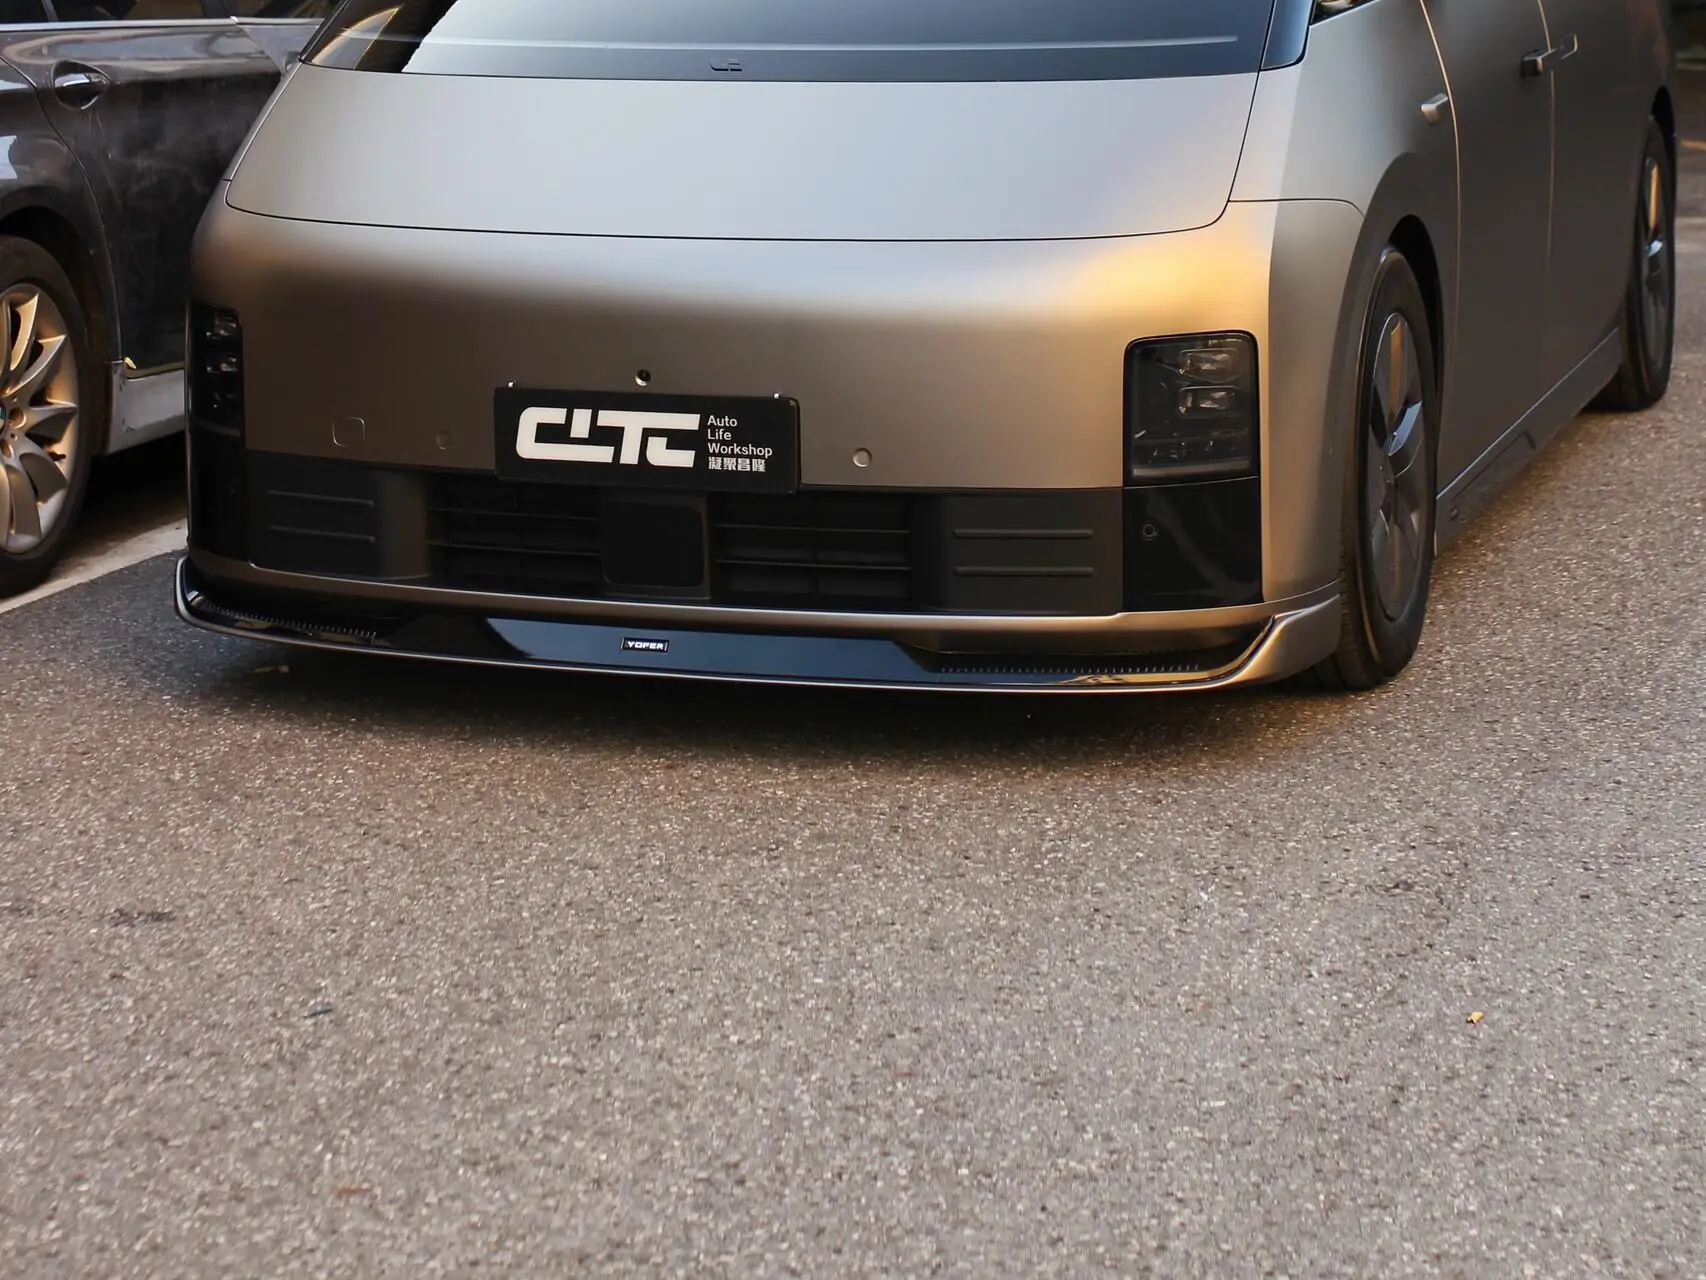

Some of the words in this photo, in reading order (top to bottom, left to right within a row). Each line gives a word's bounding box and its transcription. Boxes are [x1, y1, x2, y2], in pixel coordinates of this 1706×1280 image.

[707, 415, 738, 427] Auto
[707, 428, 732, 441] Life
[707, 442, 773, 459] Workshop
[627, 640, 664, 650] YOFER
